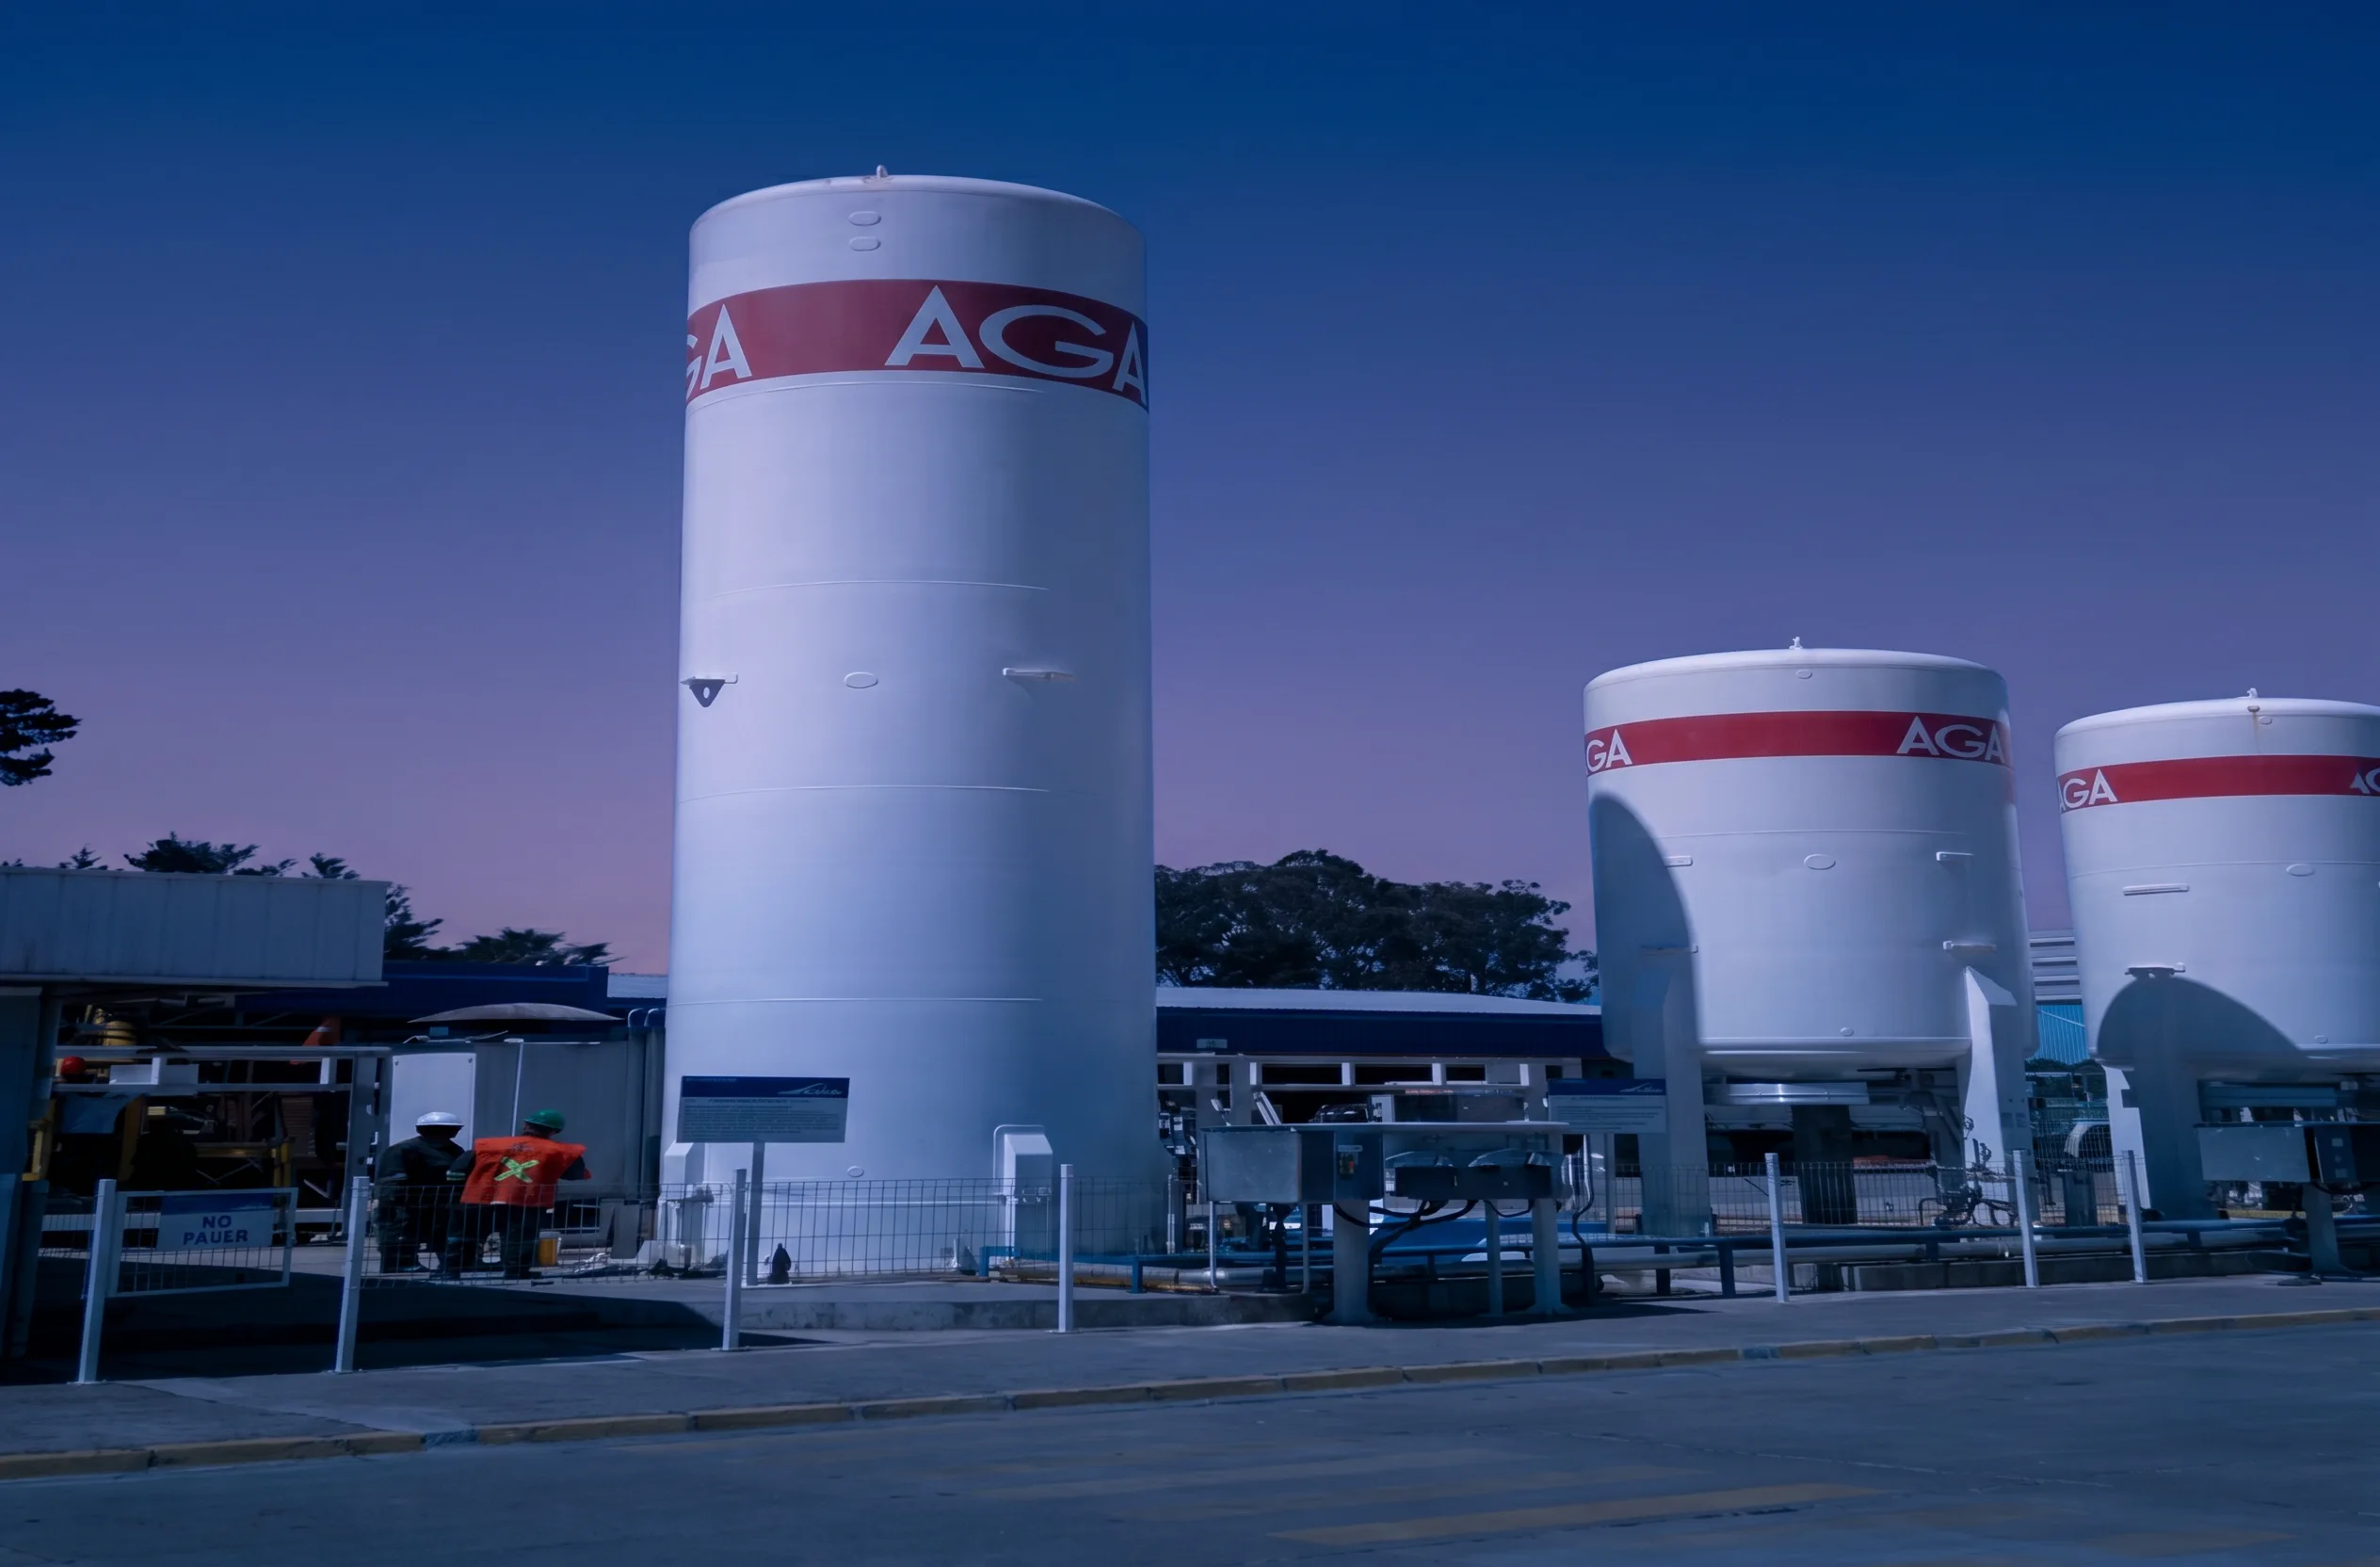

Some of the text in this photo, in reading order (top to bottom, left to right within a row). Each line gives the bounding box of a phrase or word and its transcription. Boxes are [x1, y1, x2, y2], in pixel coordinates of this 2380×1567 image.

[883, 284, 1148, 407] AGA
[1895, 715, 2006, 765] AGA
[202, 1215, 232, 1229] NO
